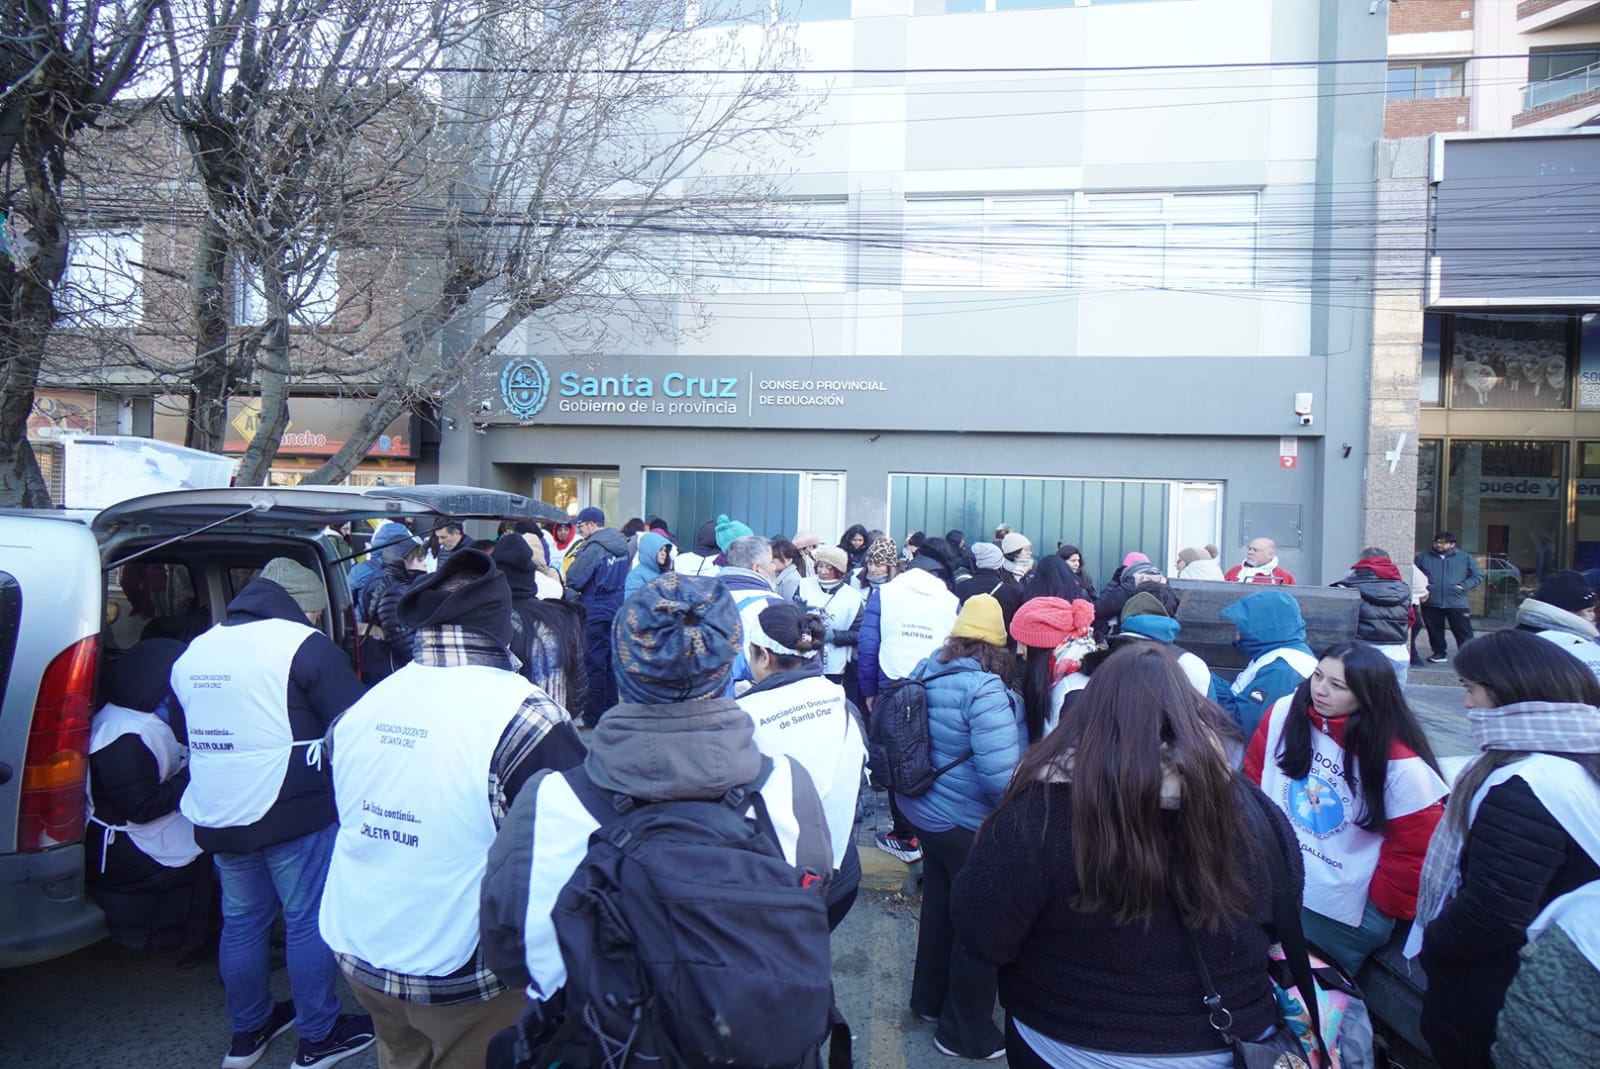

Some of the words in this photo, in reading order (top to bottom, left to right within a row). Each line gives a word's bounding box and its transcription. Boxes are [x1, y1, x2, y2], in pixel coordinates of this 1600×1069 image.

[559, 371, 653, 397] Santa
[663, 372, 737, 398] Cruz
[1582, 371, 1600, 382] SO
[760, 380, 814, 390] CONSEJO
[816, 380, 887, 391] PROVINCIAL
[760, 395, 775, 405] DE
[777, 393, 845, 406] EDUCACIÓN
[559, 400, 626, 413] Gobierno
[629, 400, 649, 414] de
[651, 400, 665, 414] la
[668, 401, 737, 416] provincia
[779, 720, 791, 730] de
[791, 712, 816, 725] Santa
[816, 707, 832, 718] Cruz
[360, 822, 391, 841] CALETA
[392, 829, 419, 849] OLIVIA
